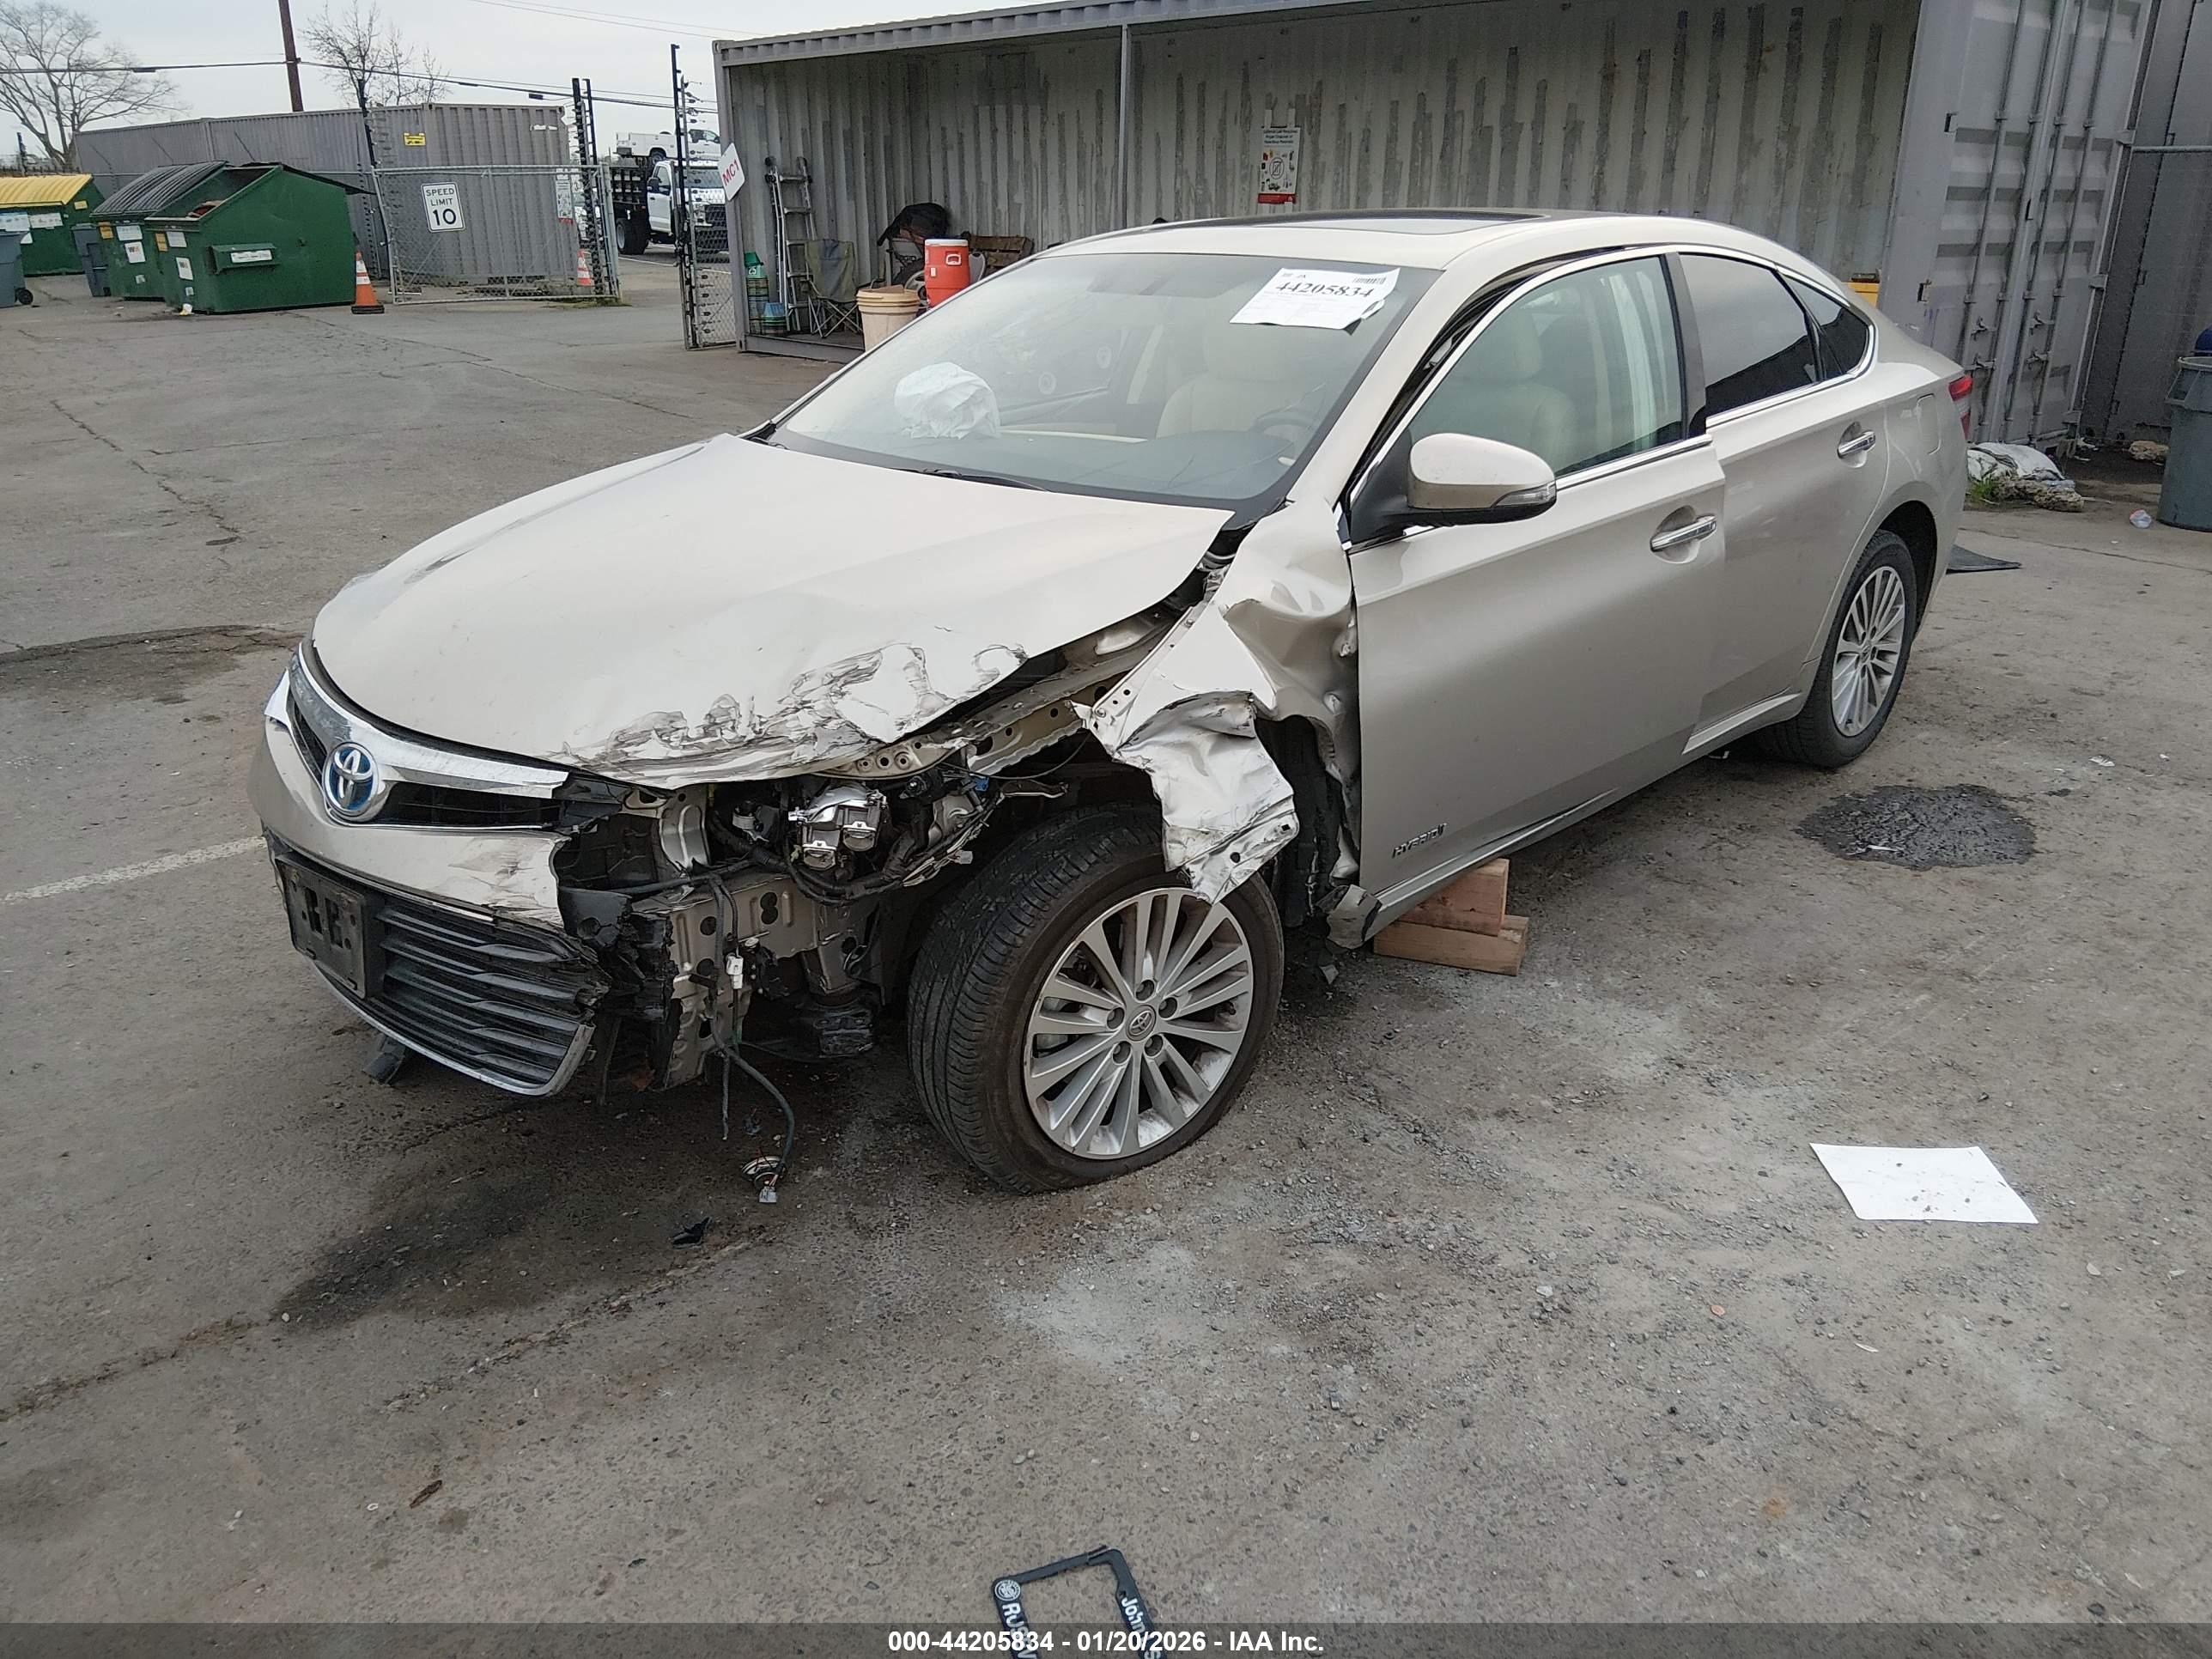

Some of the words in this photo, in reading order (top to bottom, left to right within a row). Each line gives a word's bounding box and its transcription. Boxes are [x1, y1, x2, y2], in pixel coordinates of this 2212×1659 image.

[722, 159, 739, 186] MC1
[425, 187, 455, 198] SPEED
[430, 198, 453, 207] LIMIT
[432, 208, 457, 227] 10
[1276, 281, 1376, 298] 44205834
